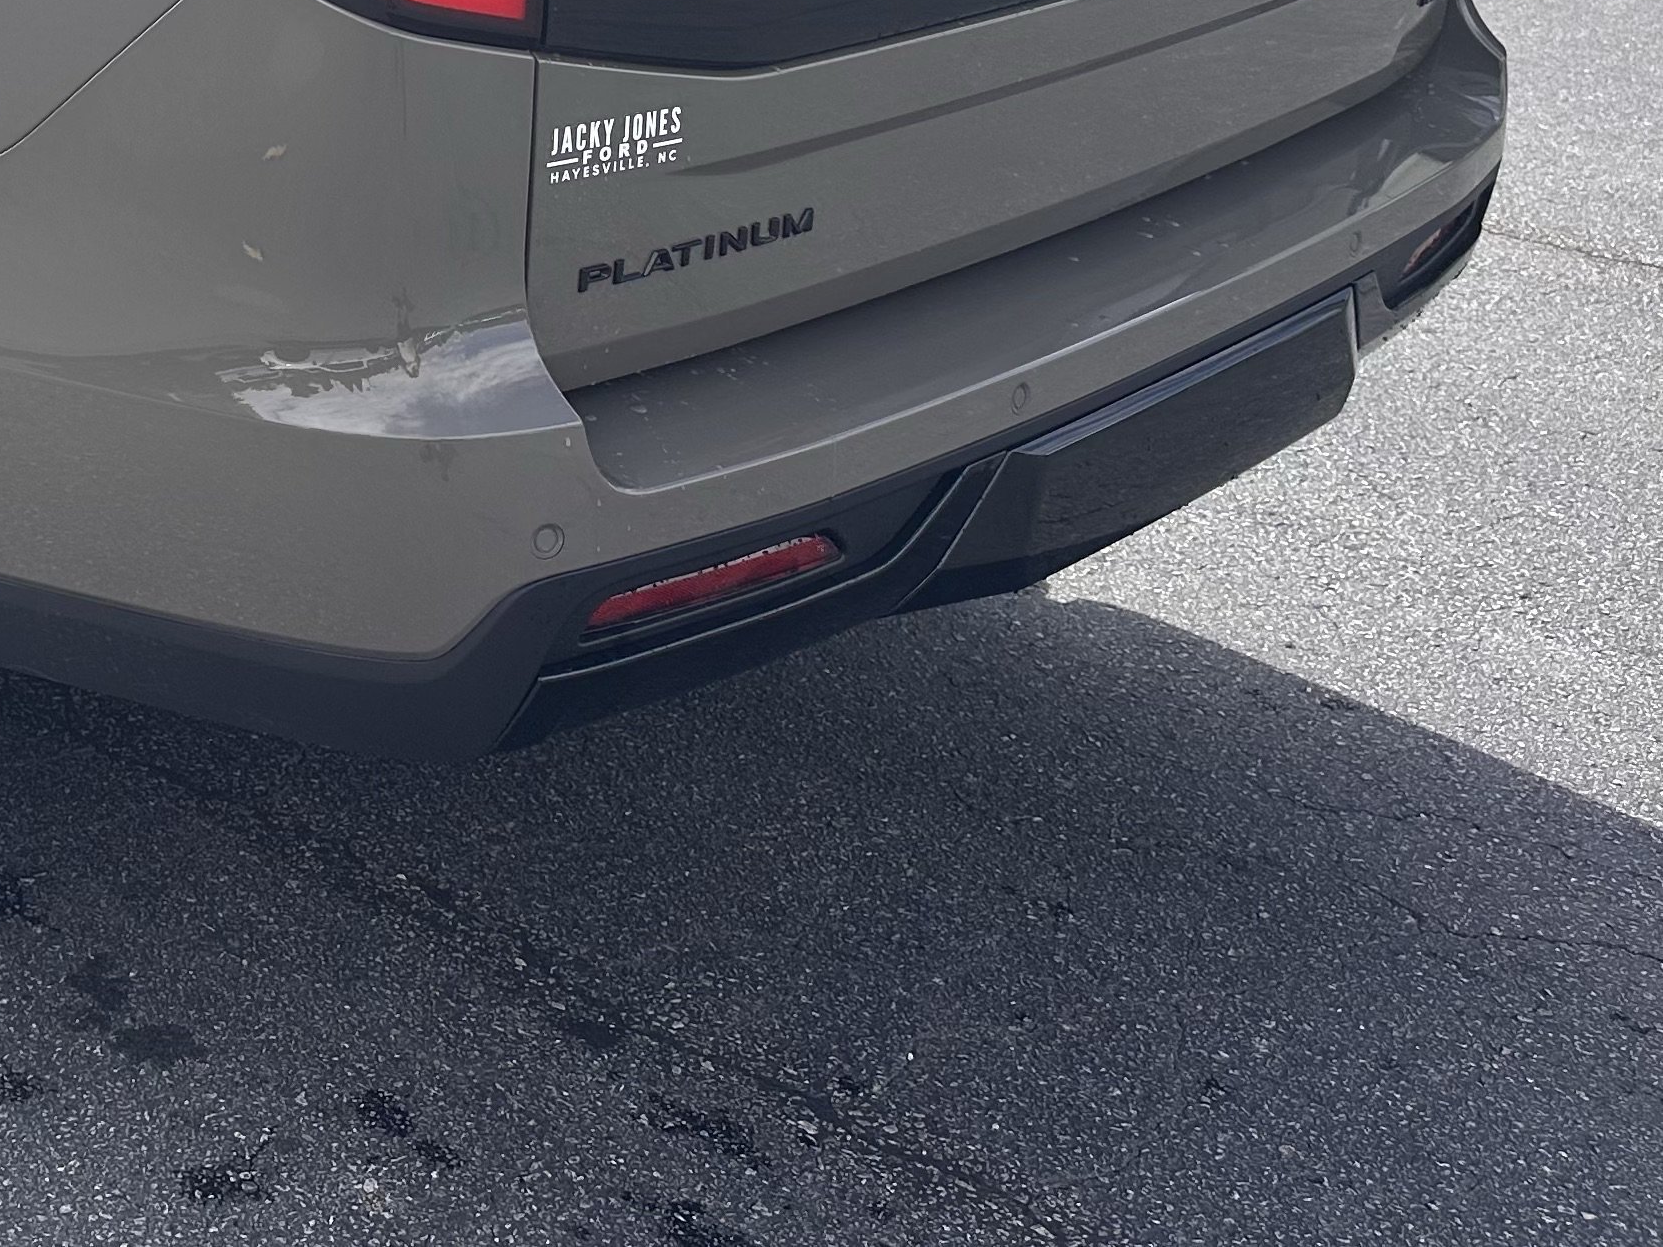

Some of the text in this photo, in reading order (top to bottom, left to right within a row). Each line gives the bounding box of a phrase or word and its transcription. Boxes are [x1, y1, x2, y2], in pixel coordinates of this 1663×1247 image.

[550, 106, 683, 156] JACKY JONES
[582, 140, 649, 165] FORD
[657, 149, 678, 164] NC
[577, 207, 815, 293] PLATINUM
